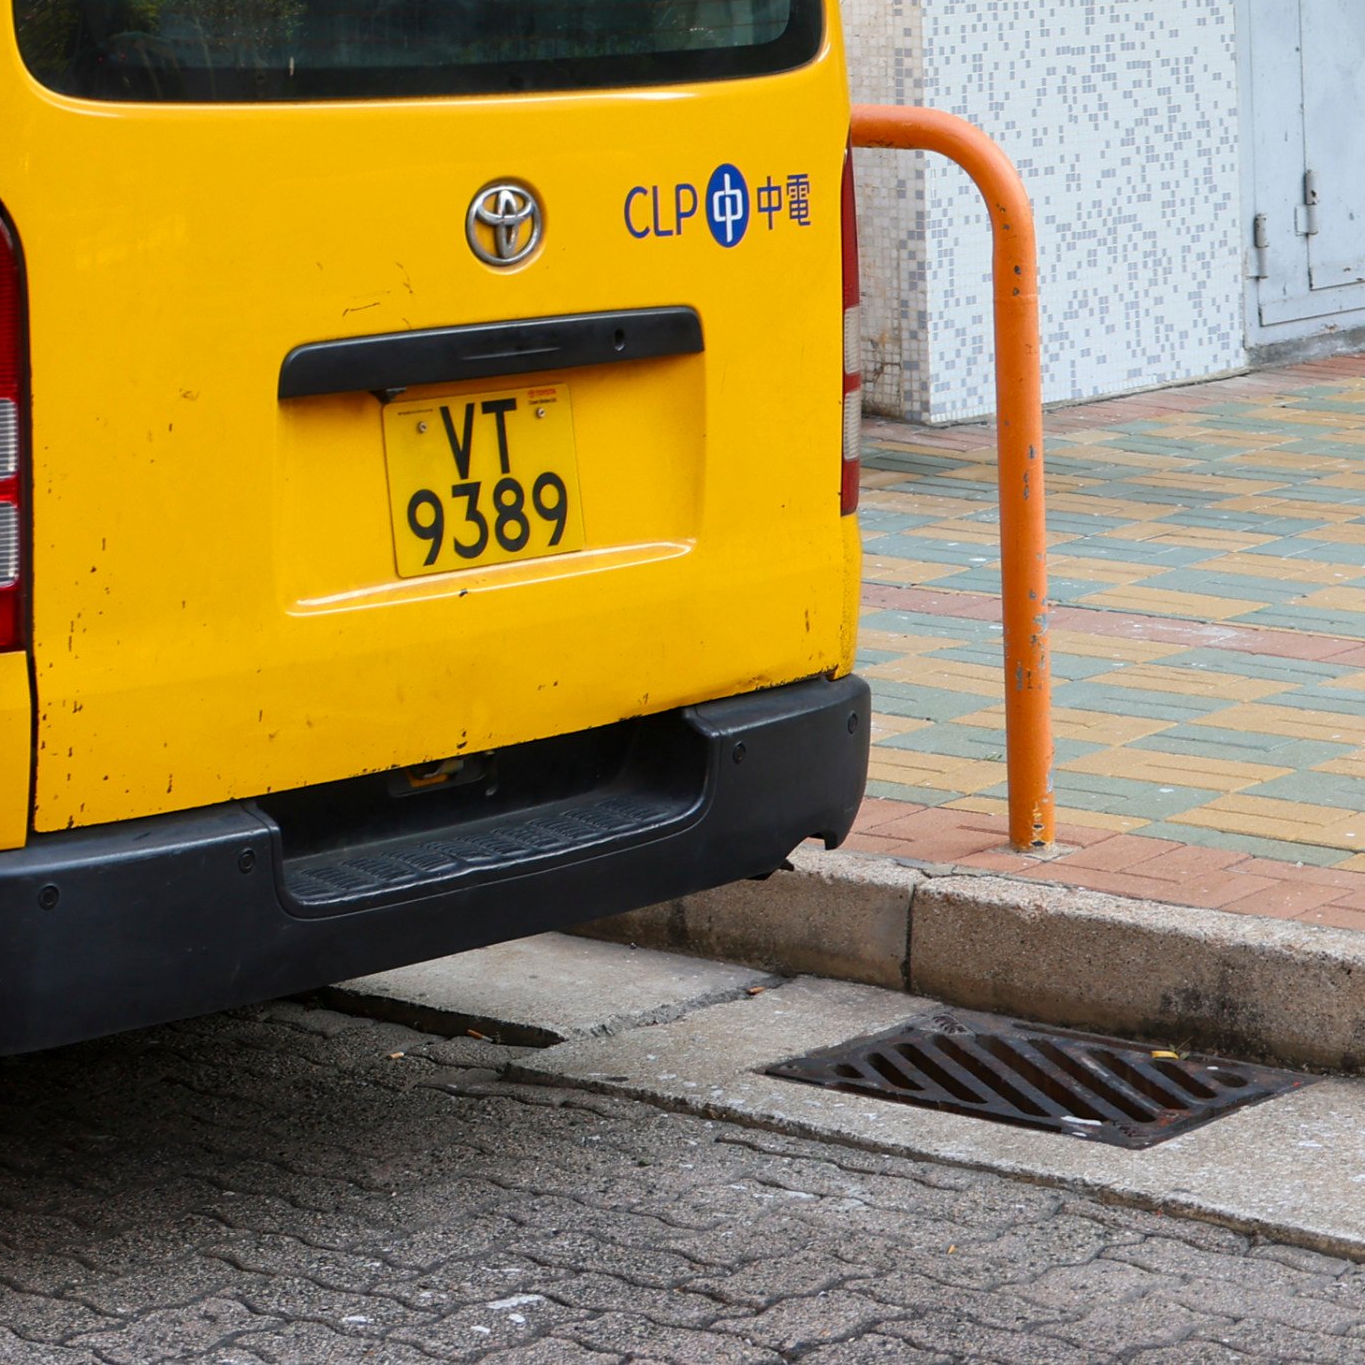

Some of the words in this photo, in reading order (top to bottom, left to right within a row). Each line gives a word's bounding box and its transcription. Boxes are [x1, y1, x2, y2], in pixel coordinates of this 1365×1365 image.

[623, 182, 699, 239] CLP
[756, 173, 812, 231] 中電
[439, 397, 518, 480] VT
[406, 471, 569, 567] 9389
